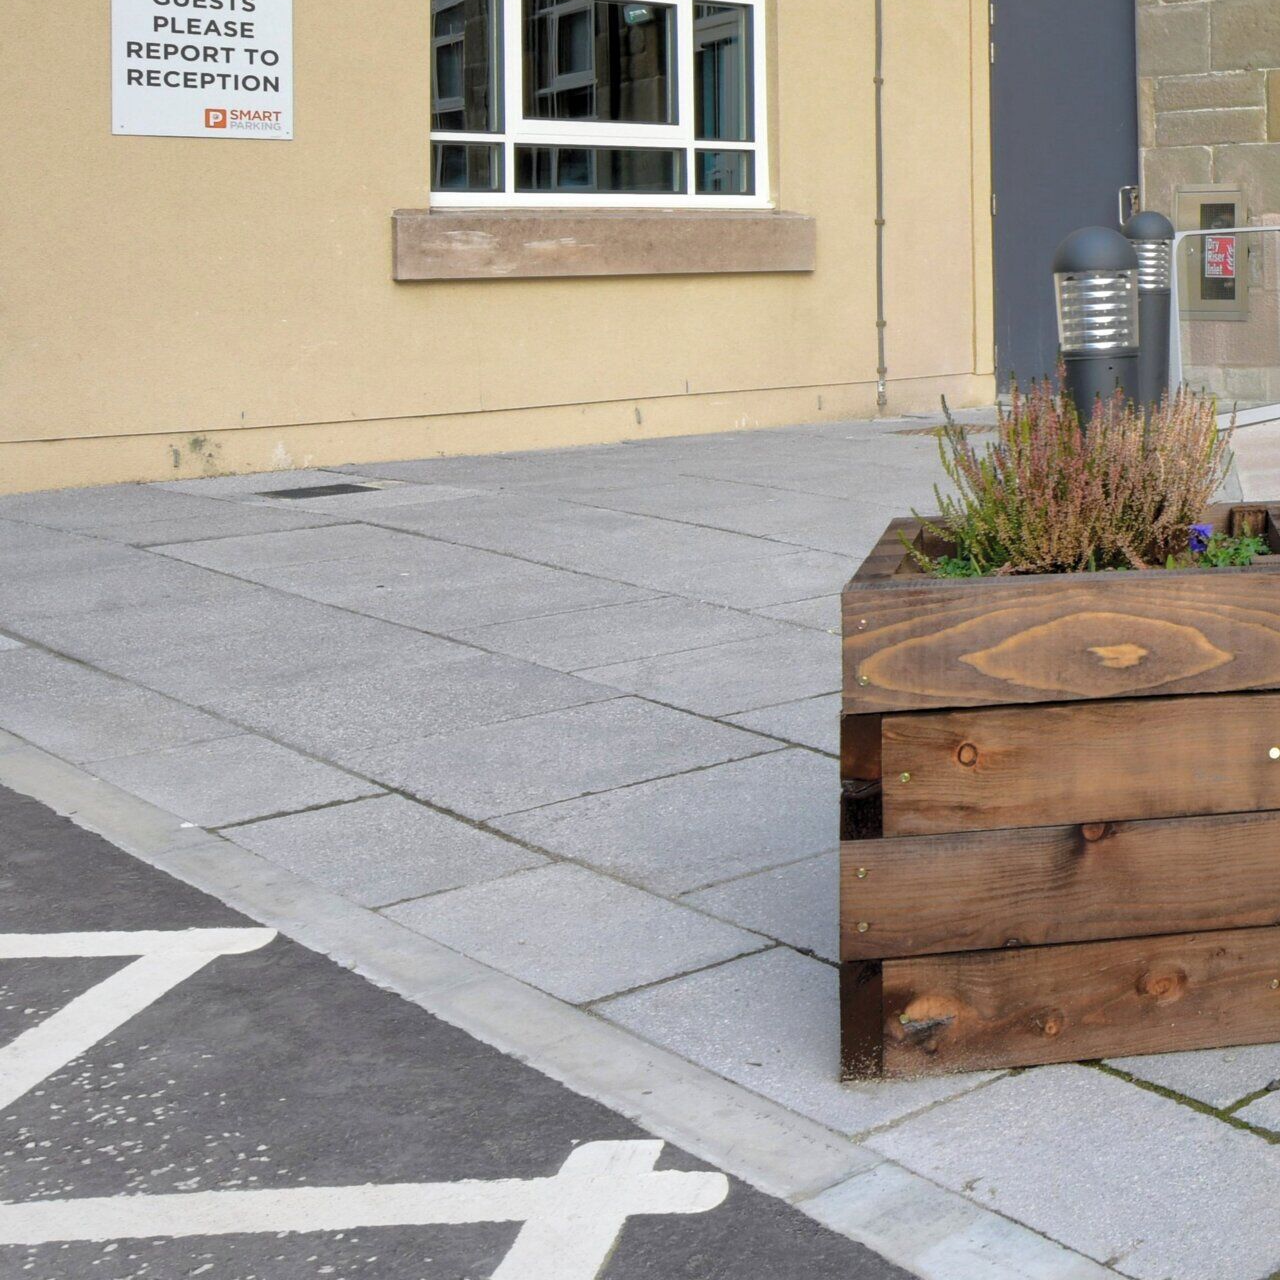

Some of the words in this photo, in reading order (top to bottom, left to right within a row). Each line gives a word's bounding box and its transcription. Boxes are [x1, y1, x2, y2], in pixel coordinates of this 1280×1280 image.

[153, 16, 255, 39] PLEASE
[126, 41, 235, 64] REPORT
[244, 48, 280, 66] TO
[127, 69, 280, 93] RECEPTION
[230, 109, 282, 122] SMART
[230, 121, 281, 131] PARKING
[1207, 238, 1220, 253] Dry
[1207, 251, 1225, 262] Riser
